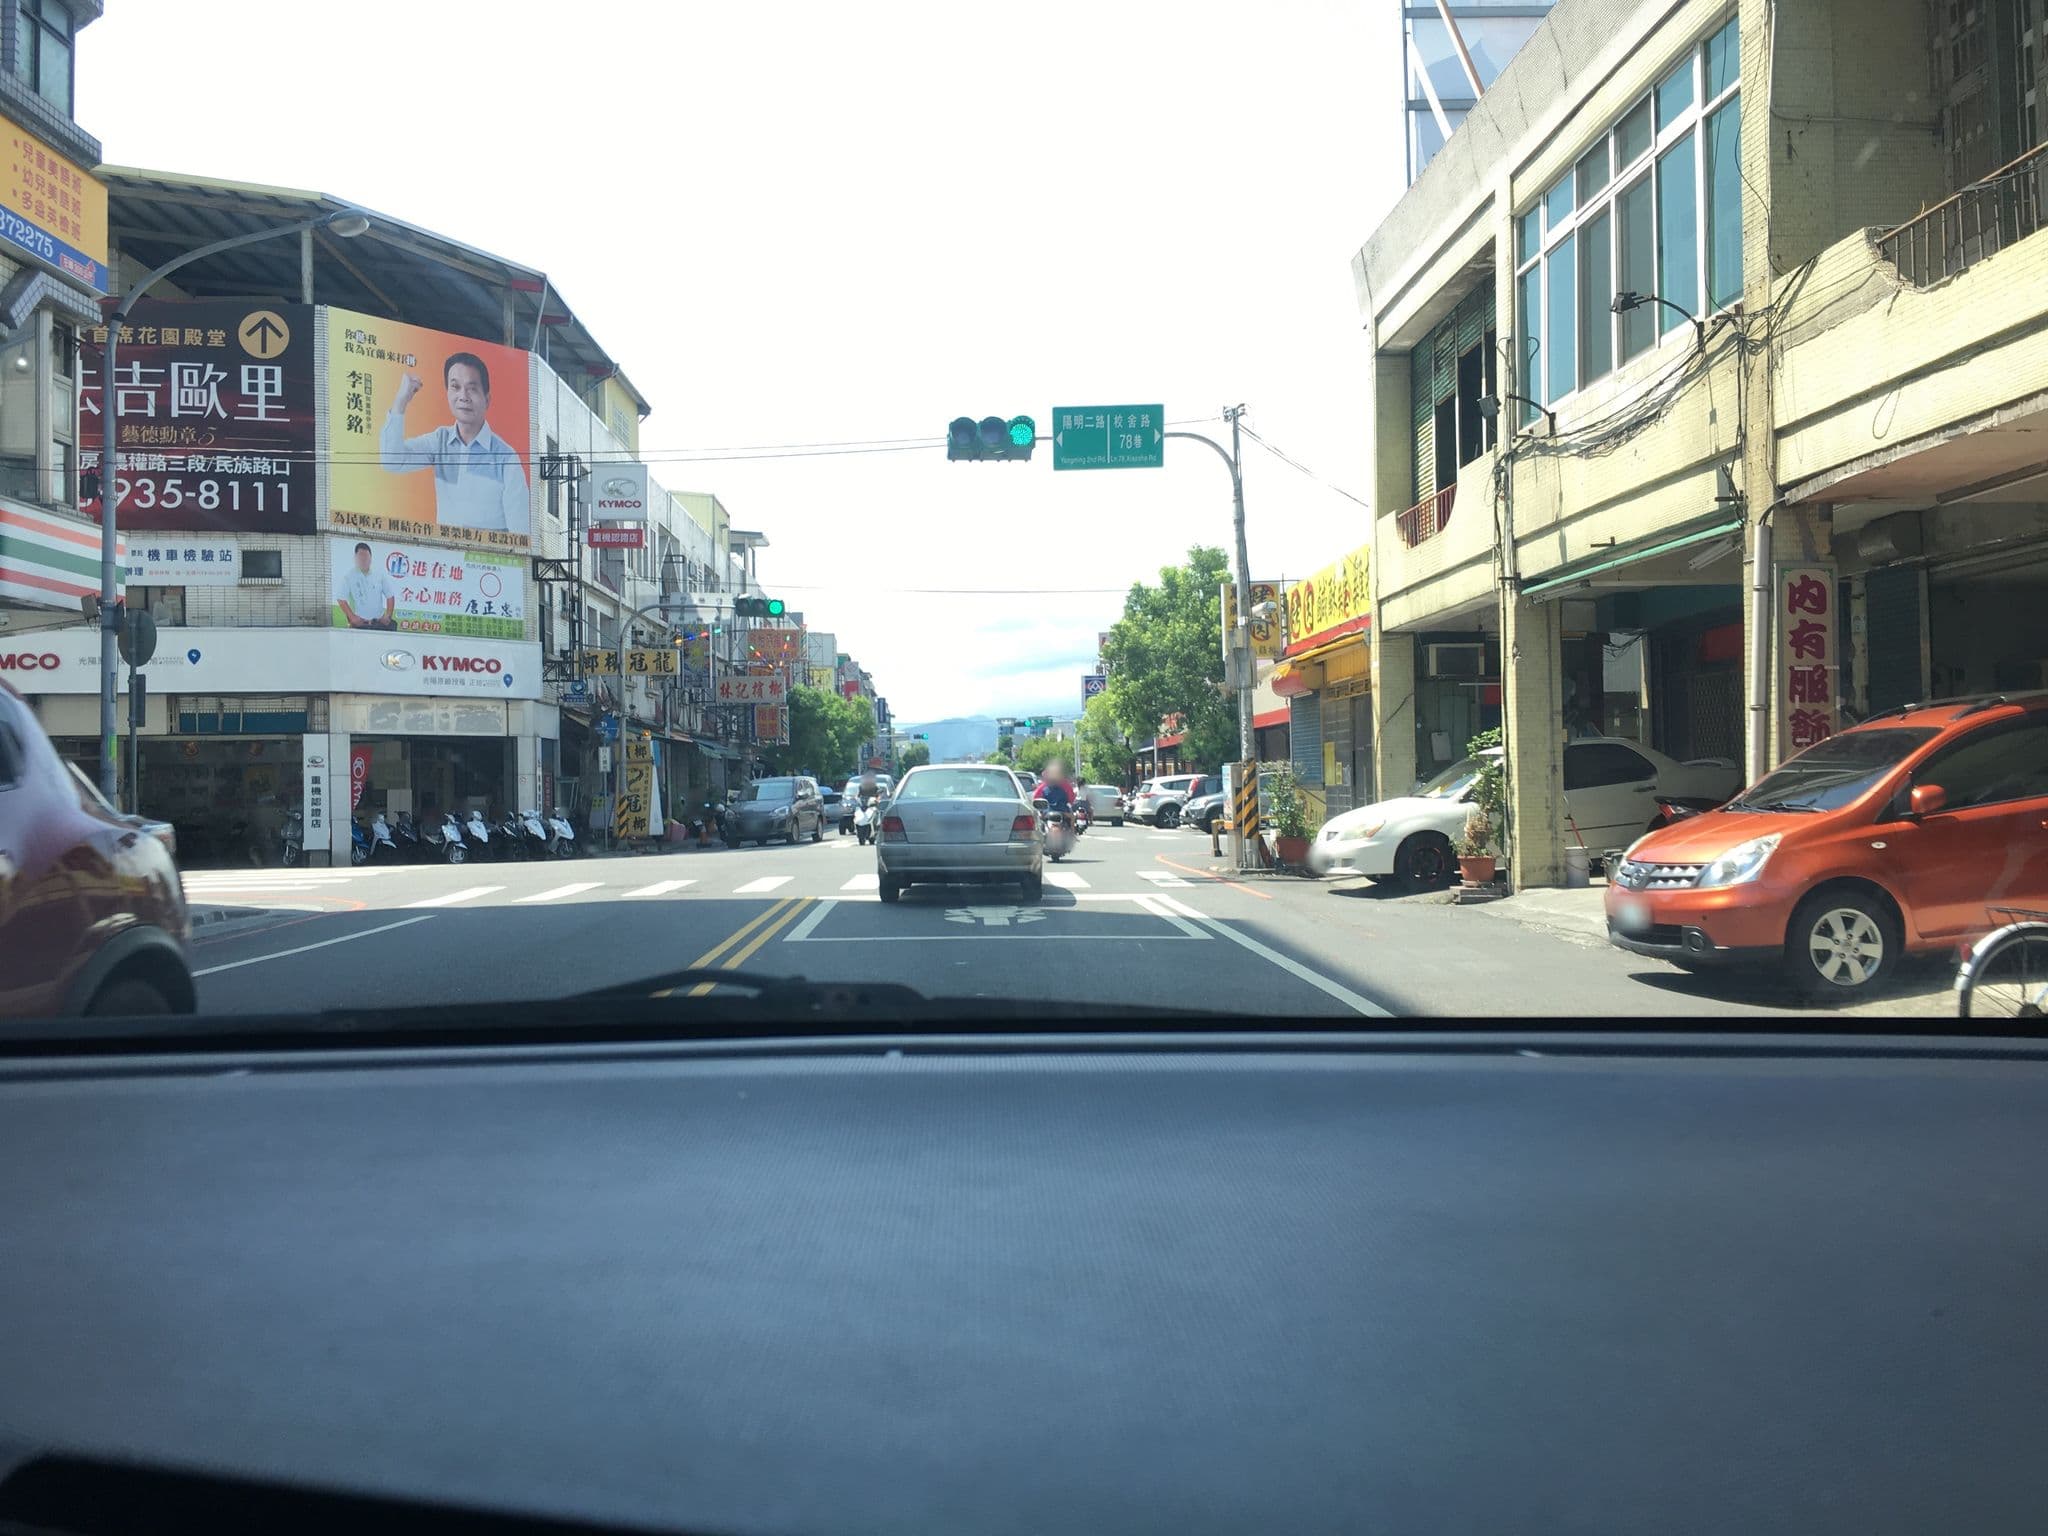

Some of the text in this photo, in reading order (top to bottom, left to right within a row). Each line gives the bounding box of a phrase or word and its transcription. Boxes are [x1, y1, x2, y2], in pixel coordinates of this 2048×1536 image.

[80, 326, 226, 348] 首席花園殿堂
[347, 371, 363, 434] 李漢銘
[1062, 414, 1105, 430] 陽明二路
[1113, 414, 1150, 429] 校舍路
[1119, 434, 1143, 449] 78巷
[599, 500, 642, 508] KYMCO
[148, 549, 232, 562] 機車檢驗站
[402, 587, 463, 606] 全心服務
[422, 655, 502, 673] KYMCO
[1788, 574, 1831, 749] 內有服飾
